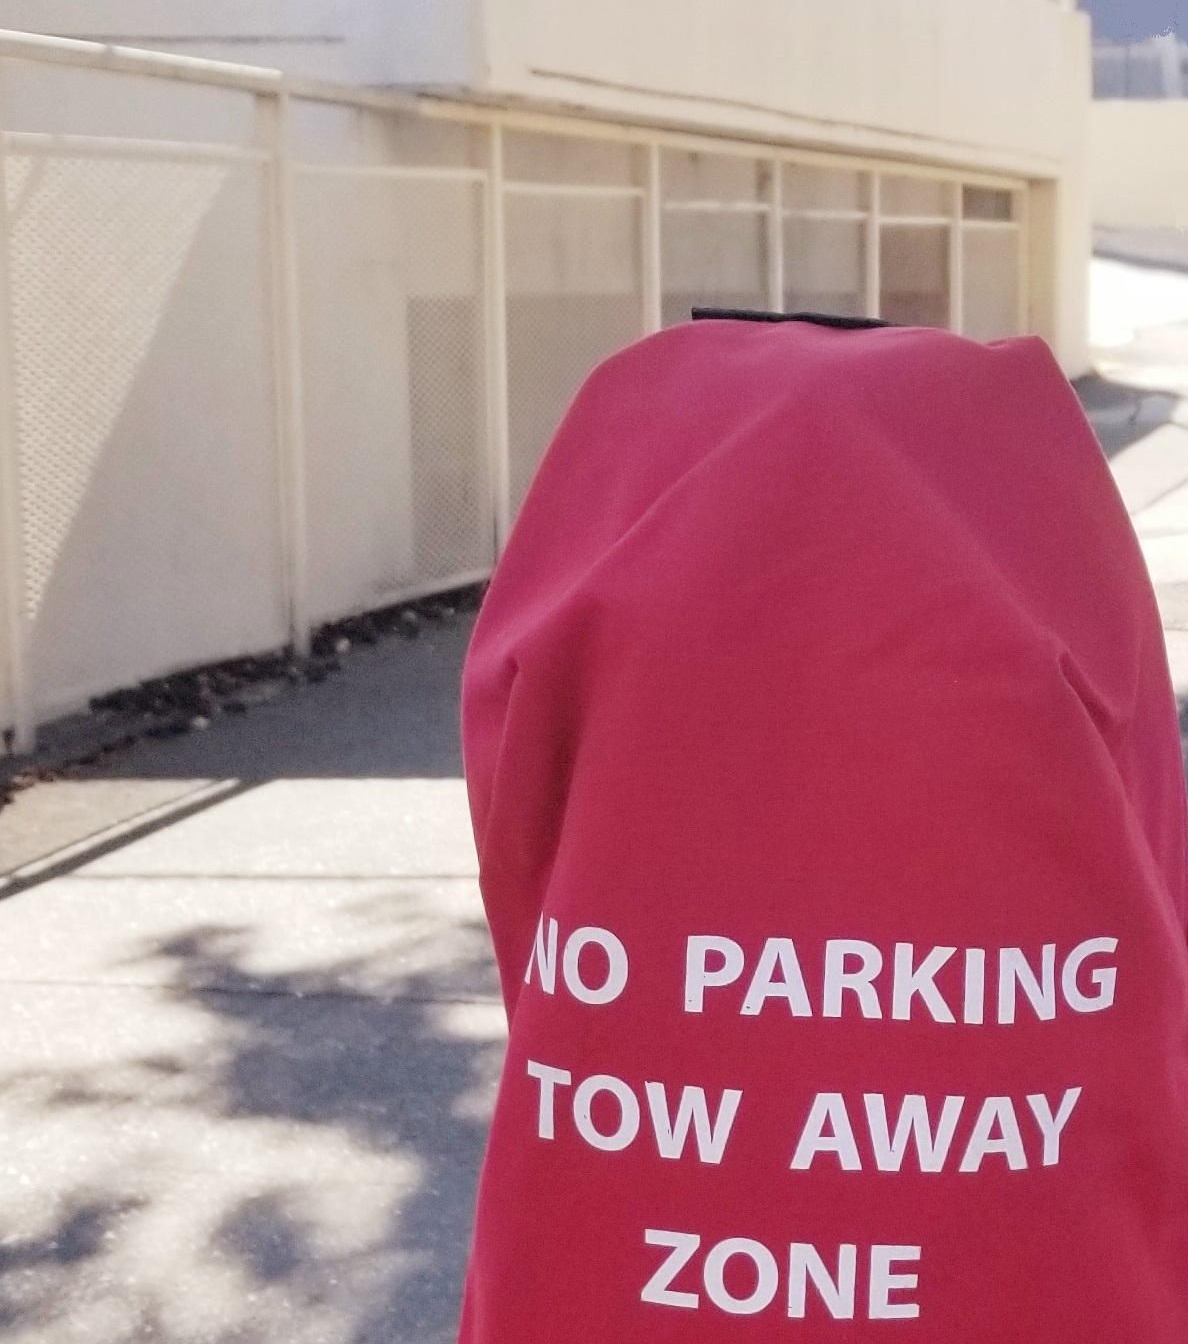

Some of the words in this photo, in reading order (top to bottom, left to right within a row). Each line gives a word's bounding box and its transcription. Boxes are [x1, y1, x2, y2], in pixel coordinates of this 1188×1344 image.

[524, 911, 629, 1005] NO
[685, 936, 1119, 1025] PARKING
[527, 1059, 744, 1165] TOW
[789, 1086, 1083, 1173] AWAY
[640, 1228, 922, 1320] ZONE
